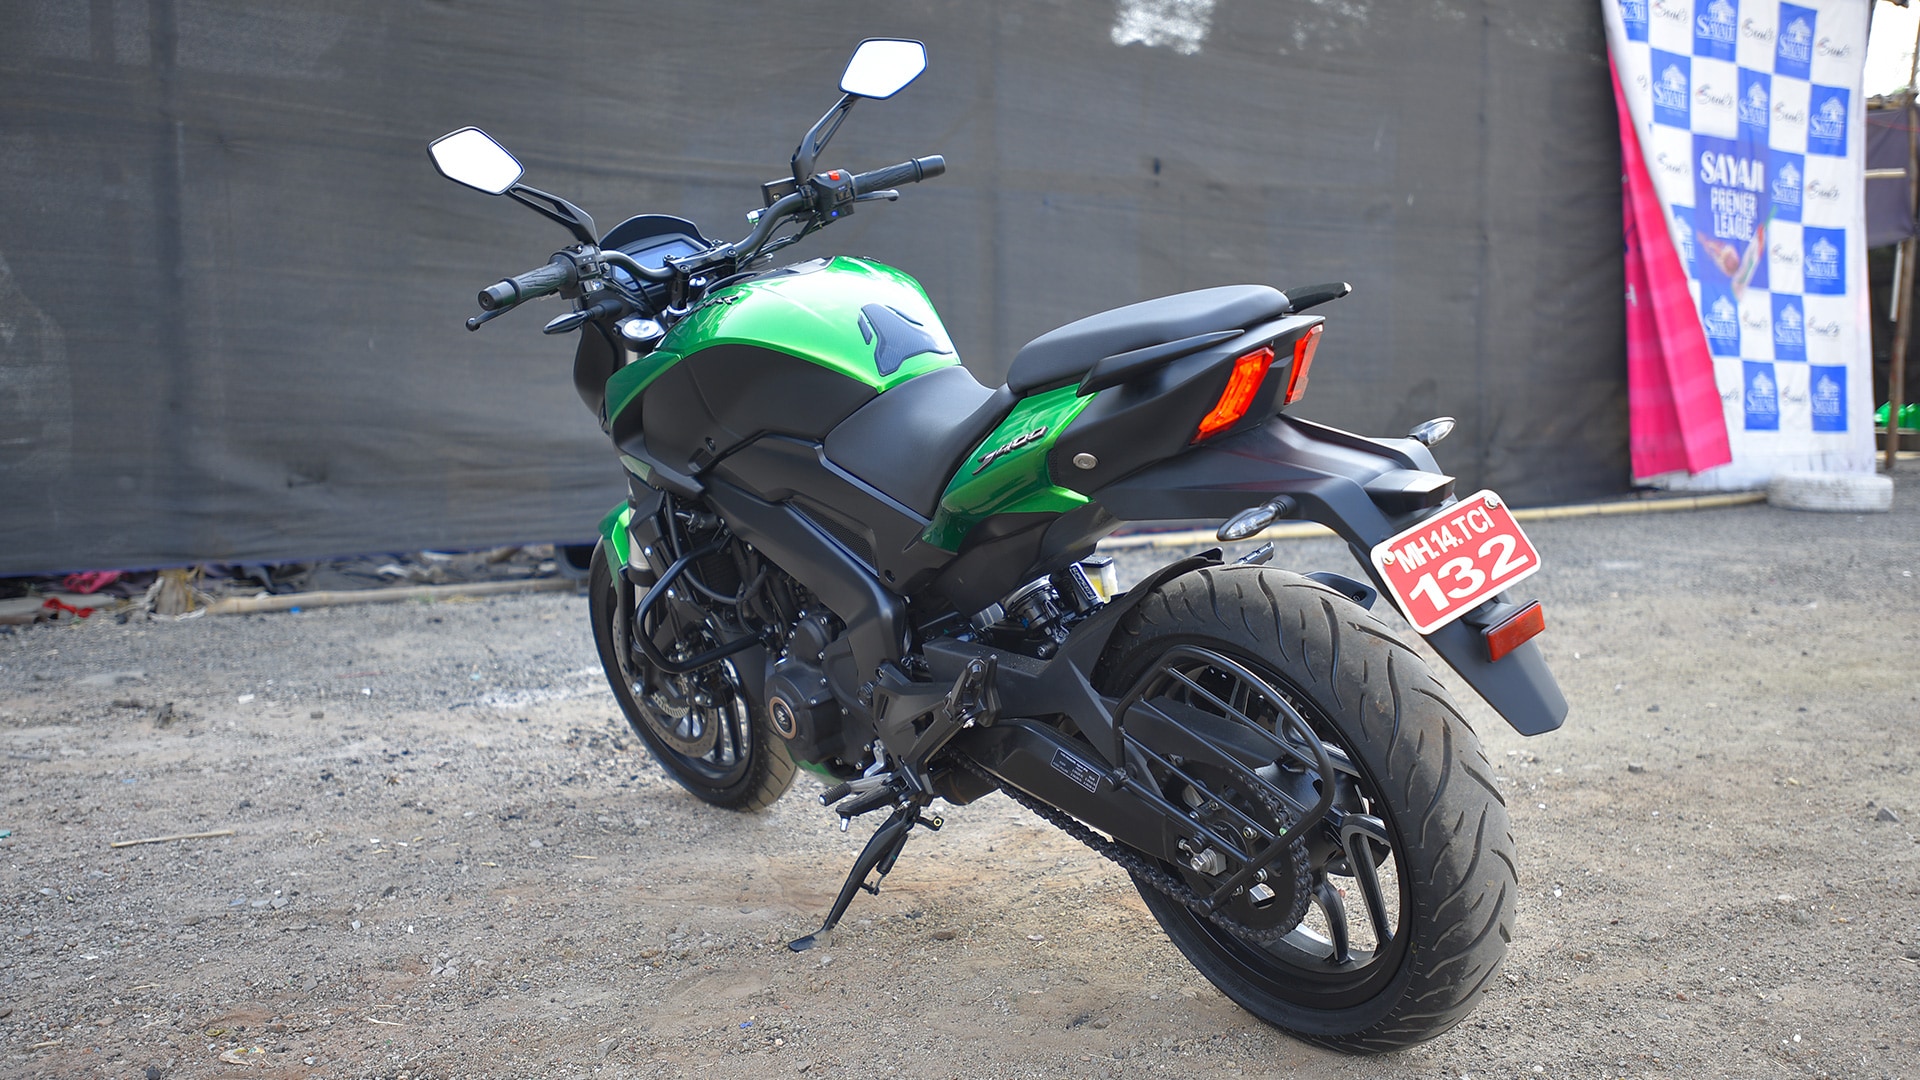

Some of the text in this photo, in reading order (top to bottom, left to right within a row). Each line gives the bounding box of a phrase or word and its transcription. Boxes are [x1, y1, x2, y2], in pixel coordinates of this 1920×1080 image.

[1700, 151, 1764, 193] SAYAJI
[1714, 213, 1753, 242] LEAGUE
[1409, 534, 1529, 611] 132
